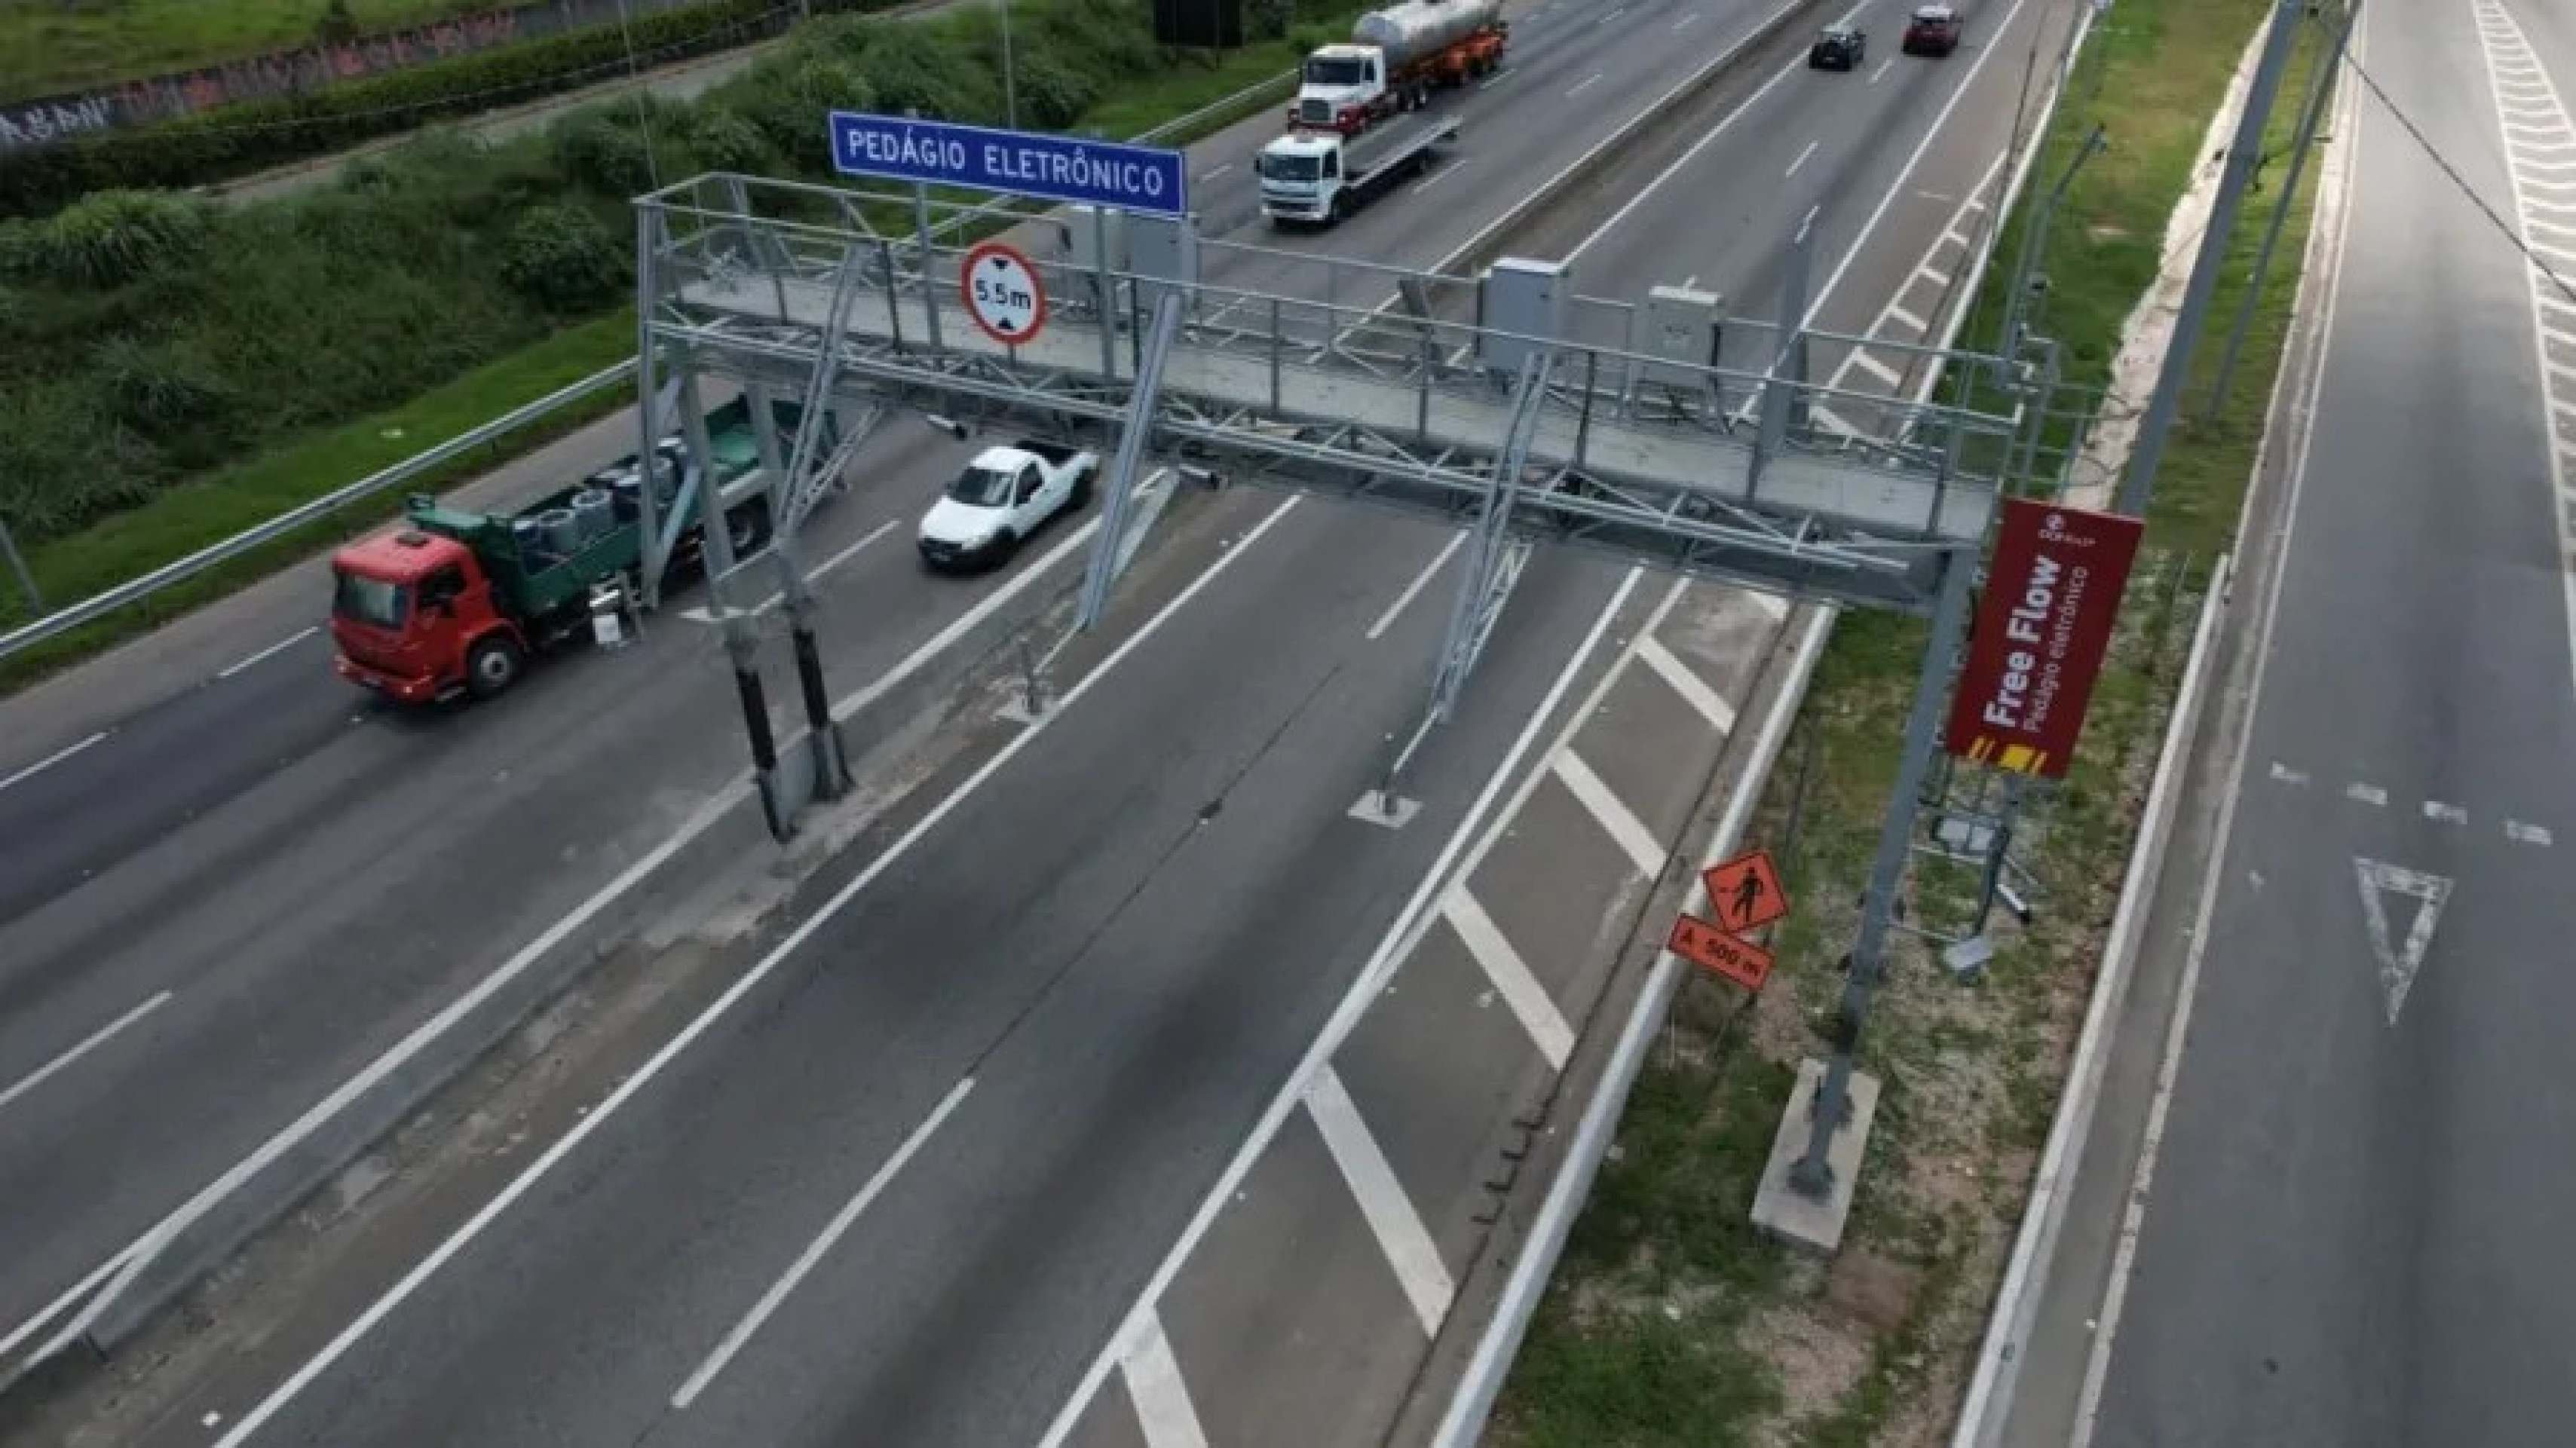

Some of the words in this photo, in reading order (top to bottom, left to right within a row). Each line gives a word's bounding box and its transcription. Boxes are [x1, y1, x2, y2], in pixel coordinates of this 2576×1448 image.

[847, 125, 966, 170] PEDÁGIO
[983, 145, 1164, 196] ELETRÔNICO
[2006, 555, 2061, 644] Flow
[1983, 651, 2035, 727] Free
[2023, 663, 2061, 733] Pedágio
